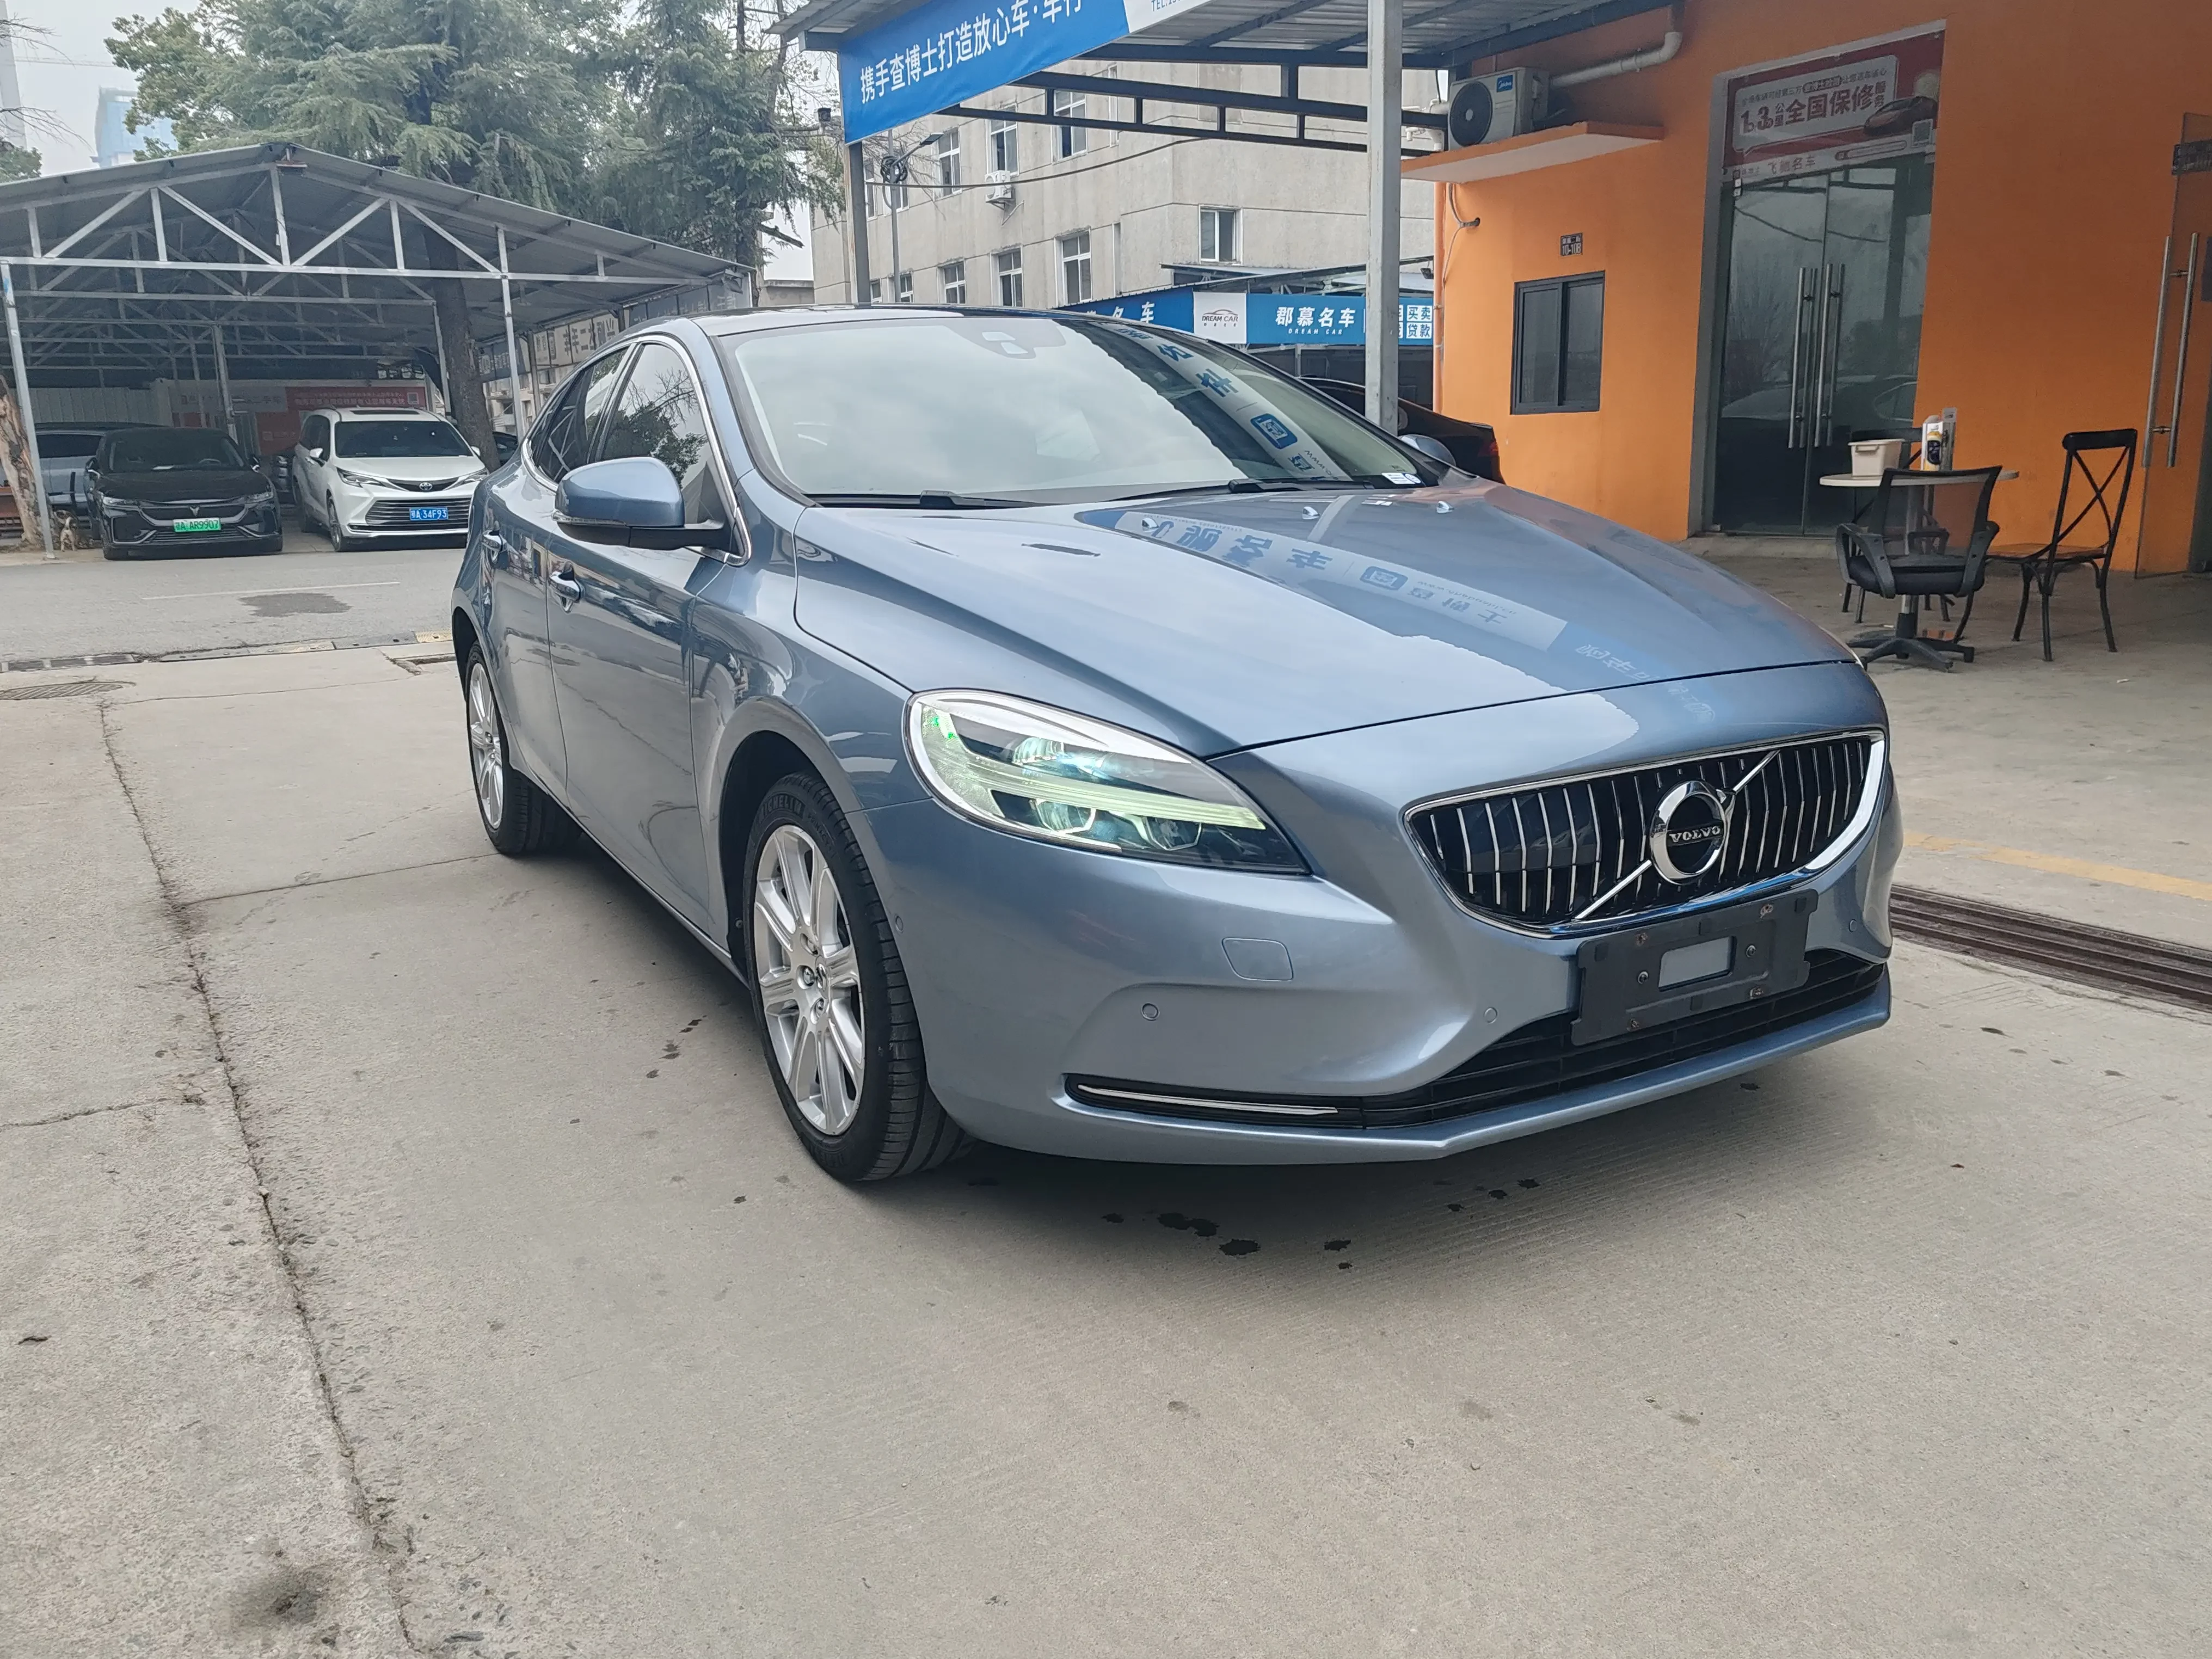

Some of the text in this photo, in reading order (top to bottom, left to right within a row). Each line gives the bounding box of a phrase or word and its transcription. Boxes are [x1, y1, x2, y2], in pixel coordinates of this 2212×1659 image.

[1275, 306, 1355, 328] 郡慕名车
[1408, 306, 1431, 320] 买卖
[1408, 324, 1431, 337] 贷款
[1669, 826, 1721, 843] VOLVO
